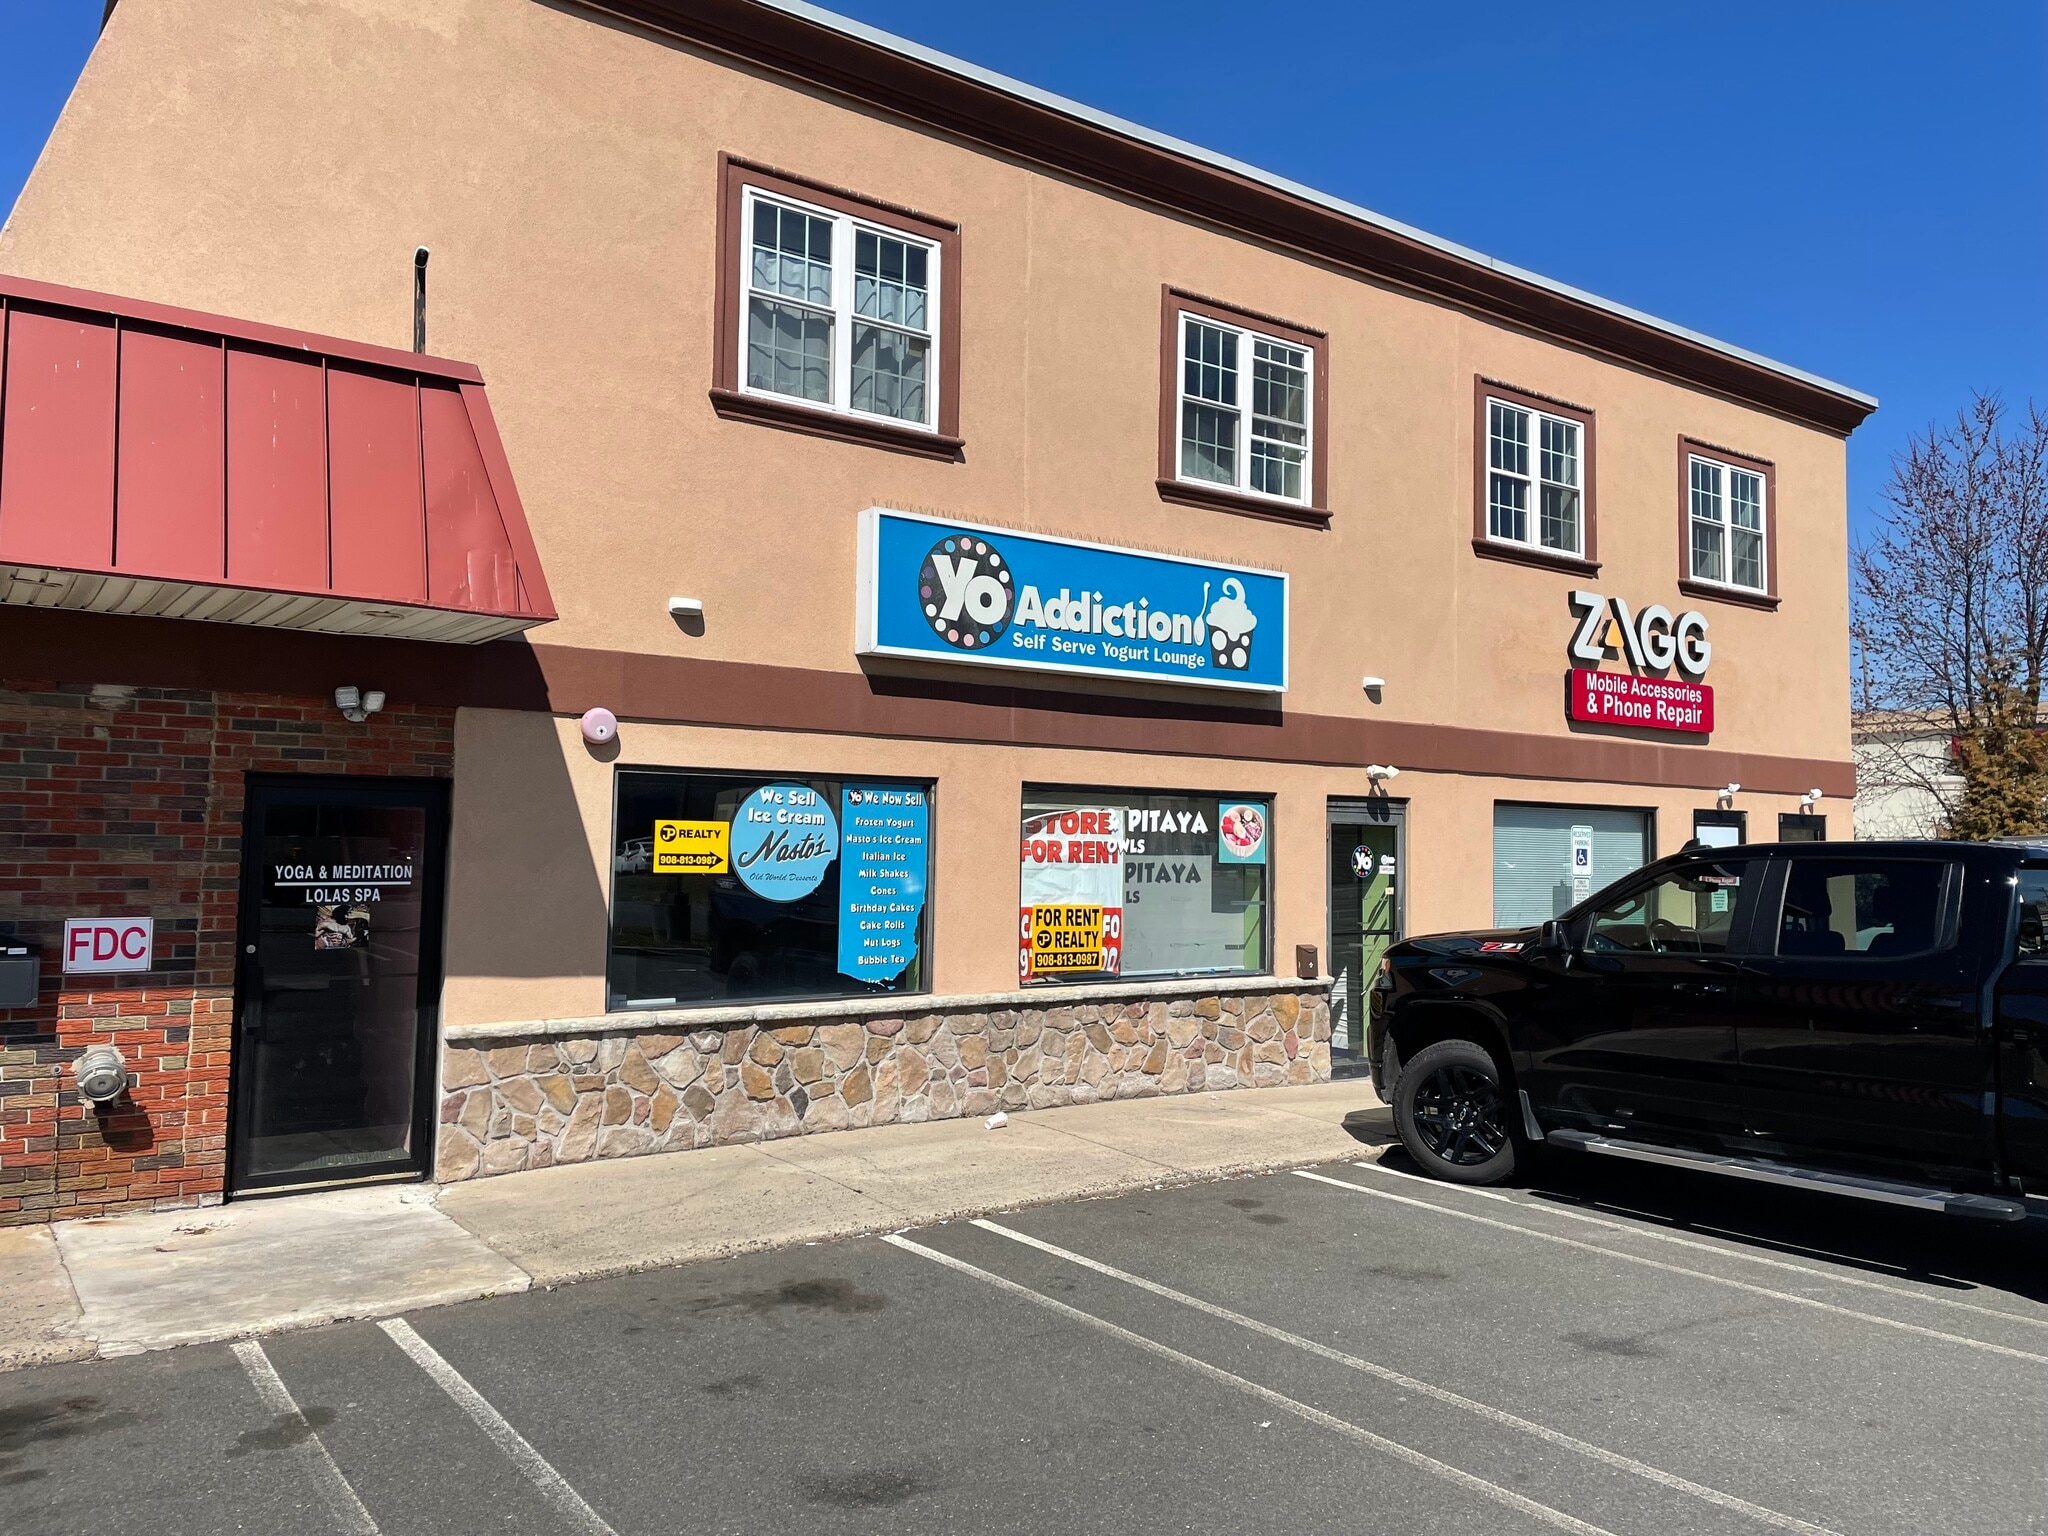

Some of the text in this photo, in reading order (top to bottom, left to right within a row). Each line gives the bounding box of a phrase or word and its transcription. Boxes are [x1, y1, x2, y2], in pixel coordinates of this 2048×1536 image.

[931, 554, 1193, 646] Yo Addiction
[1568, 590, 1712, 675] ZAGG
[1012, 631, 1206, 669] Self Serve Yogurt Lounge
[1586, 672, 1703, 703] Mobile Accessories
[1587, 692, 1703, 727] & Phone Repair
[760, 788, 817, 806] We Sell
[864, 791, 922, 806] We Now Sell
[748, 807, 826, 826] Ice Cream
[855, 817, 914, 829] Frozen Yogurt
[1128, 808, 1209, 835] PITAYA
[678, 829, 721, 839] REALTY
[880, 834, 892, 844] Ice
[895, 835, 922, 845] Cream
[862, 851, 907, 861] Italian Ice
[1021, 839, 1063, 864] FOR
[660, 855, 718, 865] 908-813-0987
[1355, 852, 1372, 870] Yo
[275, 865, 413, 879] YOGA & MEDITATION
[749, 872, 818, 882] Old World Desserts
[858, 868, 909, 879] Milk Shakes
[305, 888, 381, 903] LOLAS SPA
[870, 885, 896, 896] Cones
[850, 902, 915, 914] Birthday Cakes
[860, 920, 905, 930] Cake Rolls
[1035, 908, 1062, 927] FOR
[1065, 908, 1100, 927] RENT
[69, 926, 147, 962] FDC
[863, 937, 901, 948] Nut Logs
[1054, 931, 1100, 948] REALTY
[858, 954, 905, 965] Bubble Tea
[1036, 952, 1098, 967] 908-813-0987
